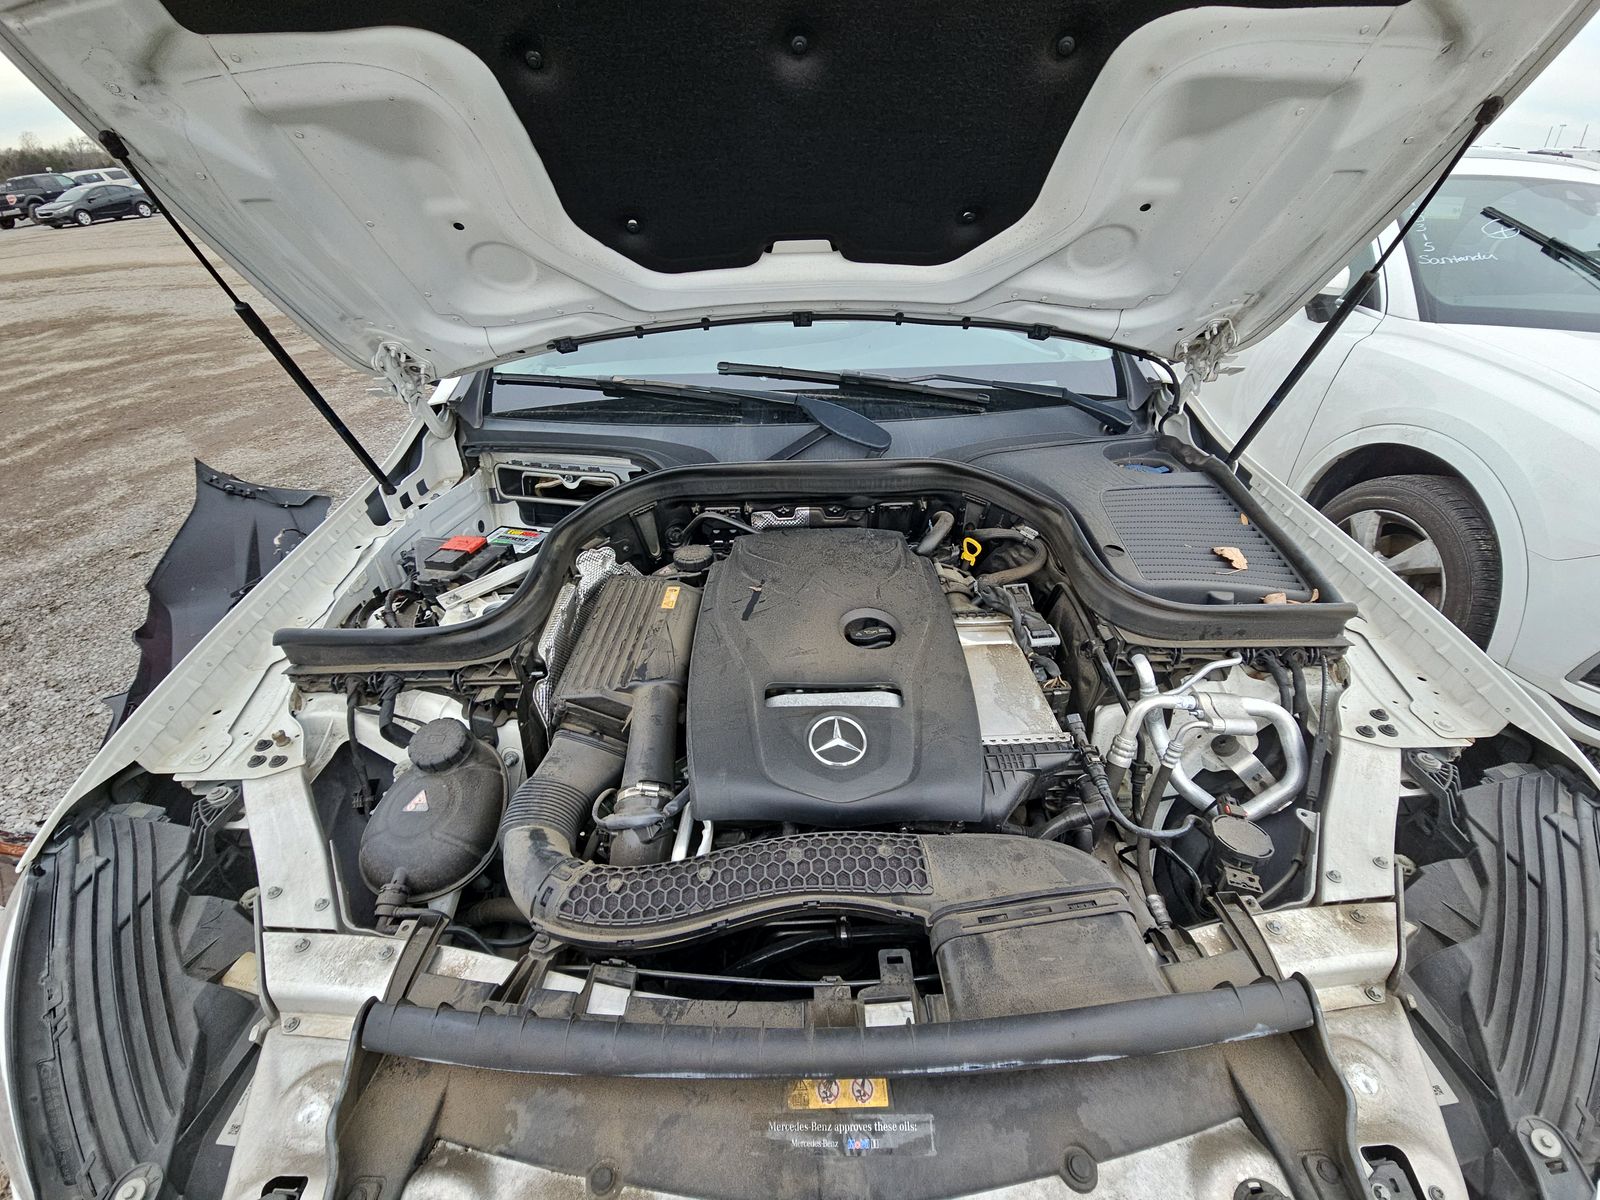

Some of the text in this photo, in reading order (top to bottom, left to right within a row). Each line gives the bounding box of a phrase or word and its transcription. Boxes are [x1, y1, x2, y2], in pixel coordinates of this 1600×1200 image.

[768, 1120, 918, 1134] Mercedes-Benz approves these oils:
[791, 1139, 839, 1148] Mercedes-Benz
